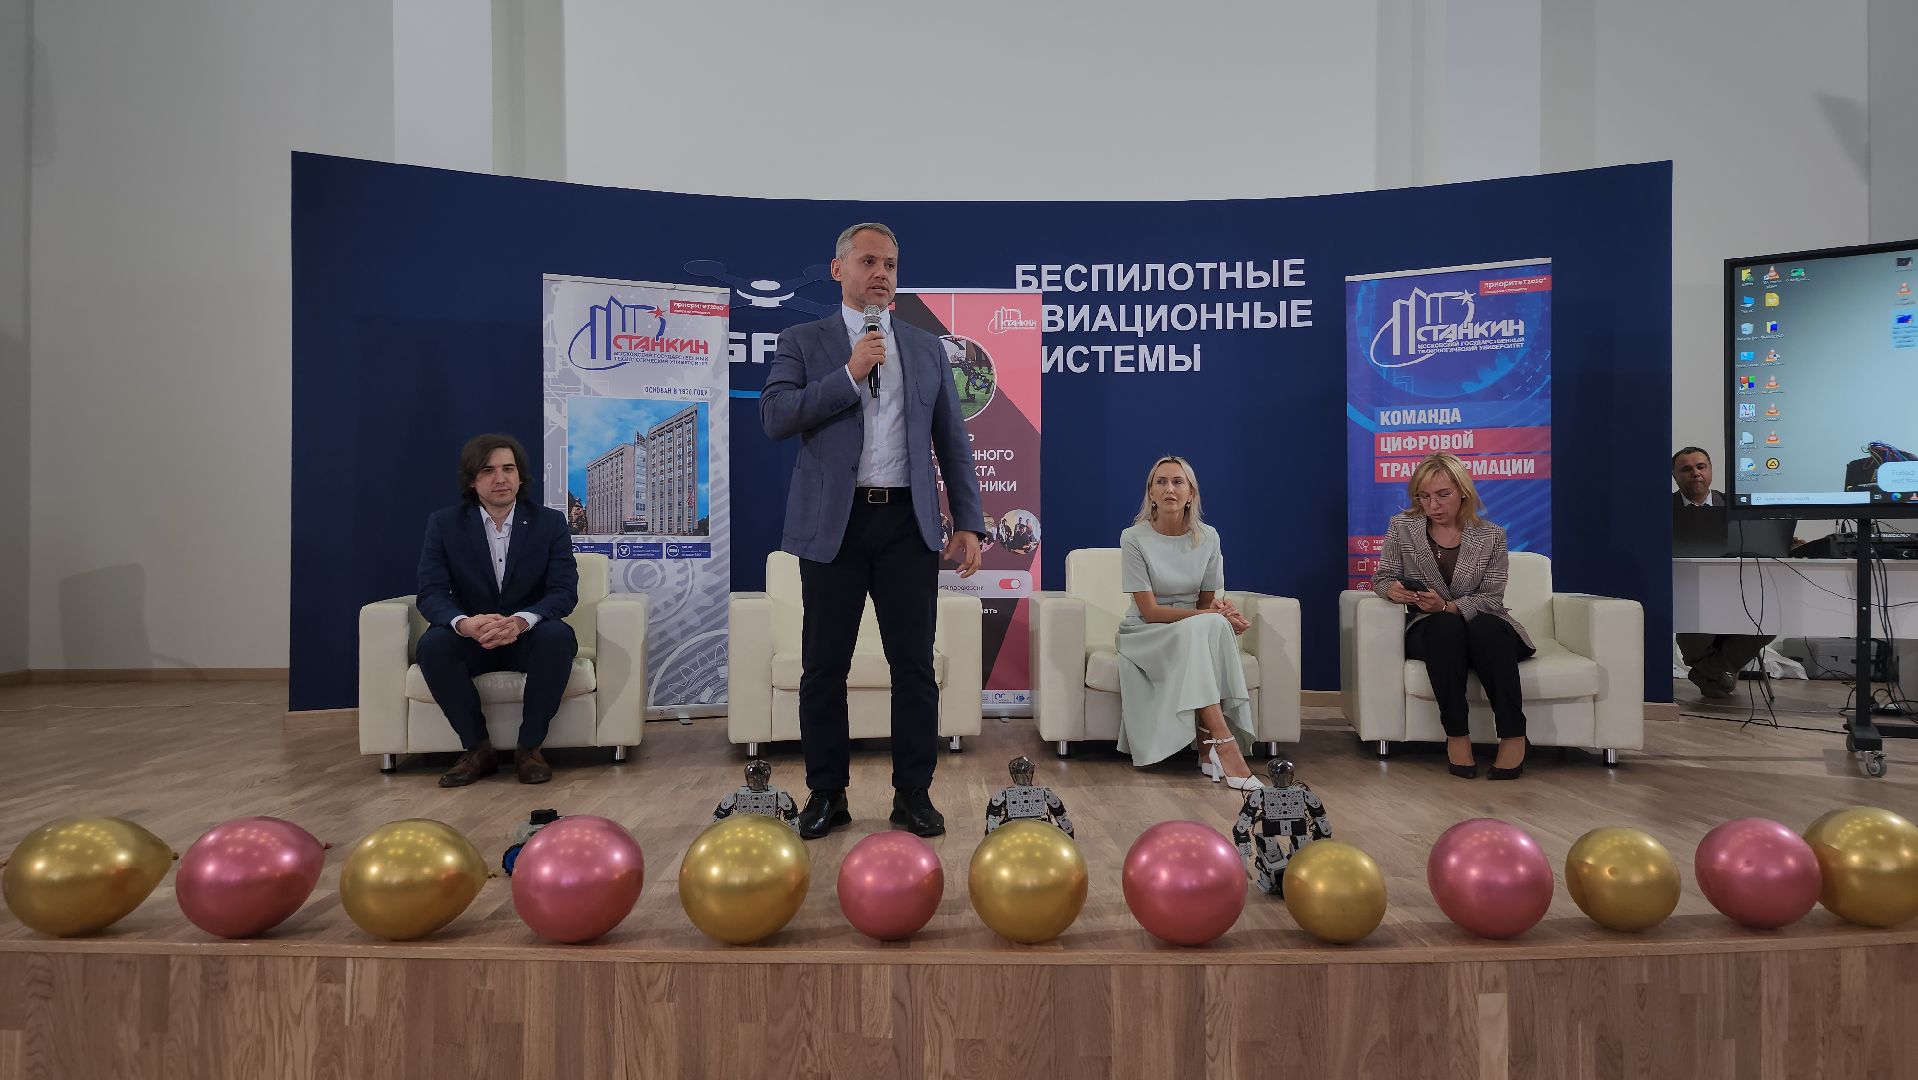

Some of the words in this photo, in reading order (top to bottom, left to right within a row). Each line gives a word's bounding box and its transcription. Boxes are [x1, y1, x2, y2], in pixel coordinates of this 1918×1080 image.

[1016, 258, 1306, 292] БЕСПИЛОТНЫЕ
[1041, 299, 1313, 338] ВИАЦИОННЫЕ
[1416, 319, 1525, 342] СТАНКИН
[612, 334, 708, 354] СТАНКИН
[1041, 343, 1201, 374] ИСТЕМЫ
[644, 386, 672, 395] ОСНОВАН
[1380, 407, 1462, 426] КОМАНДА
[1380, 430, 1474, 454] ЦИФРОВОЙ
